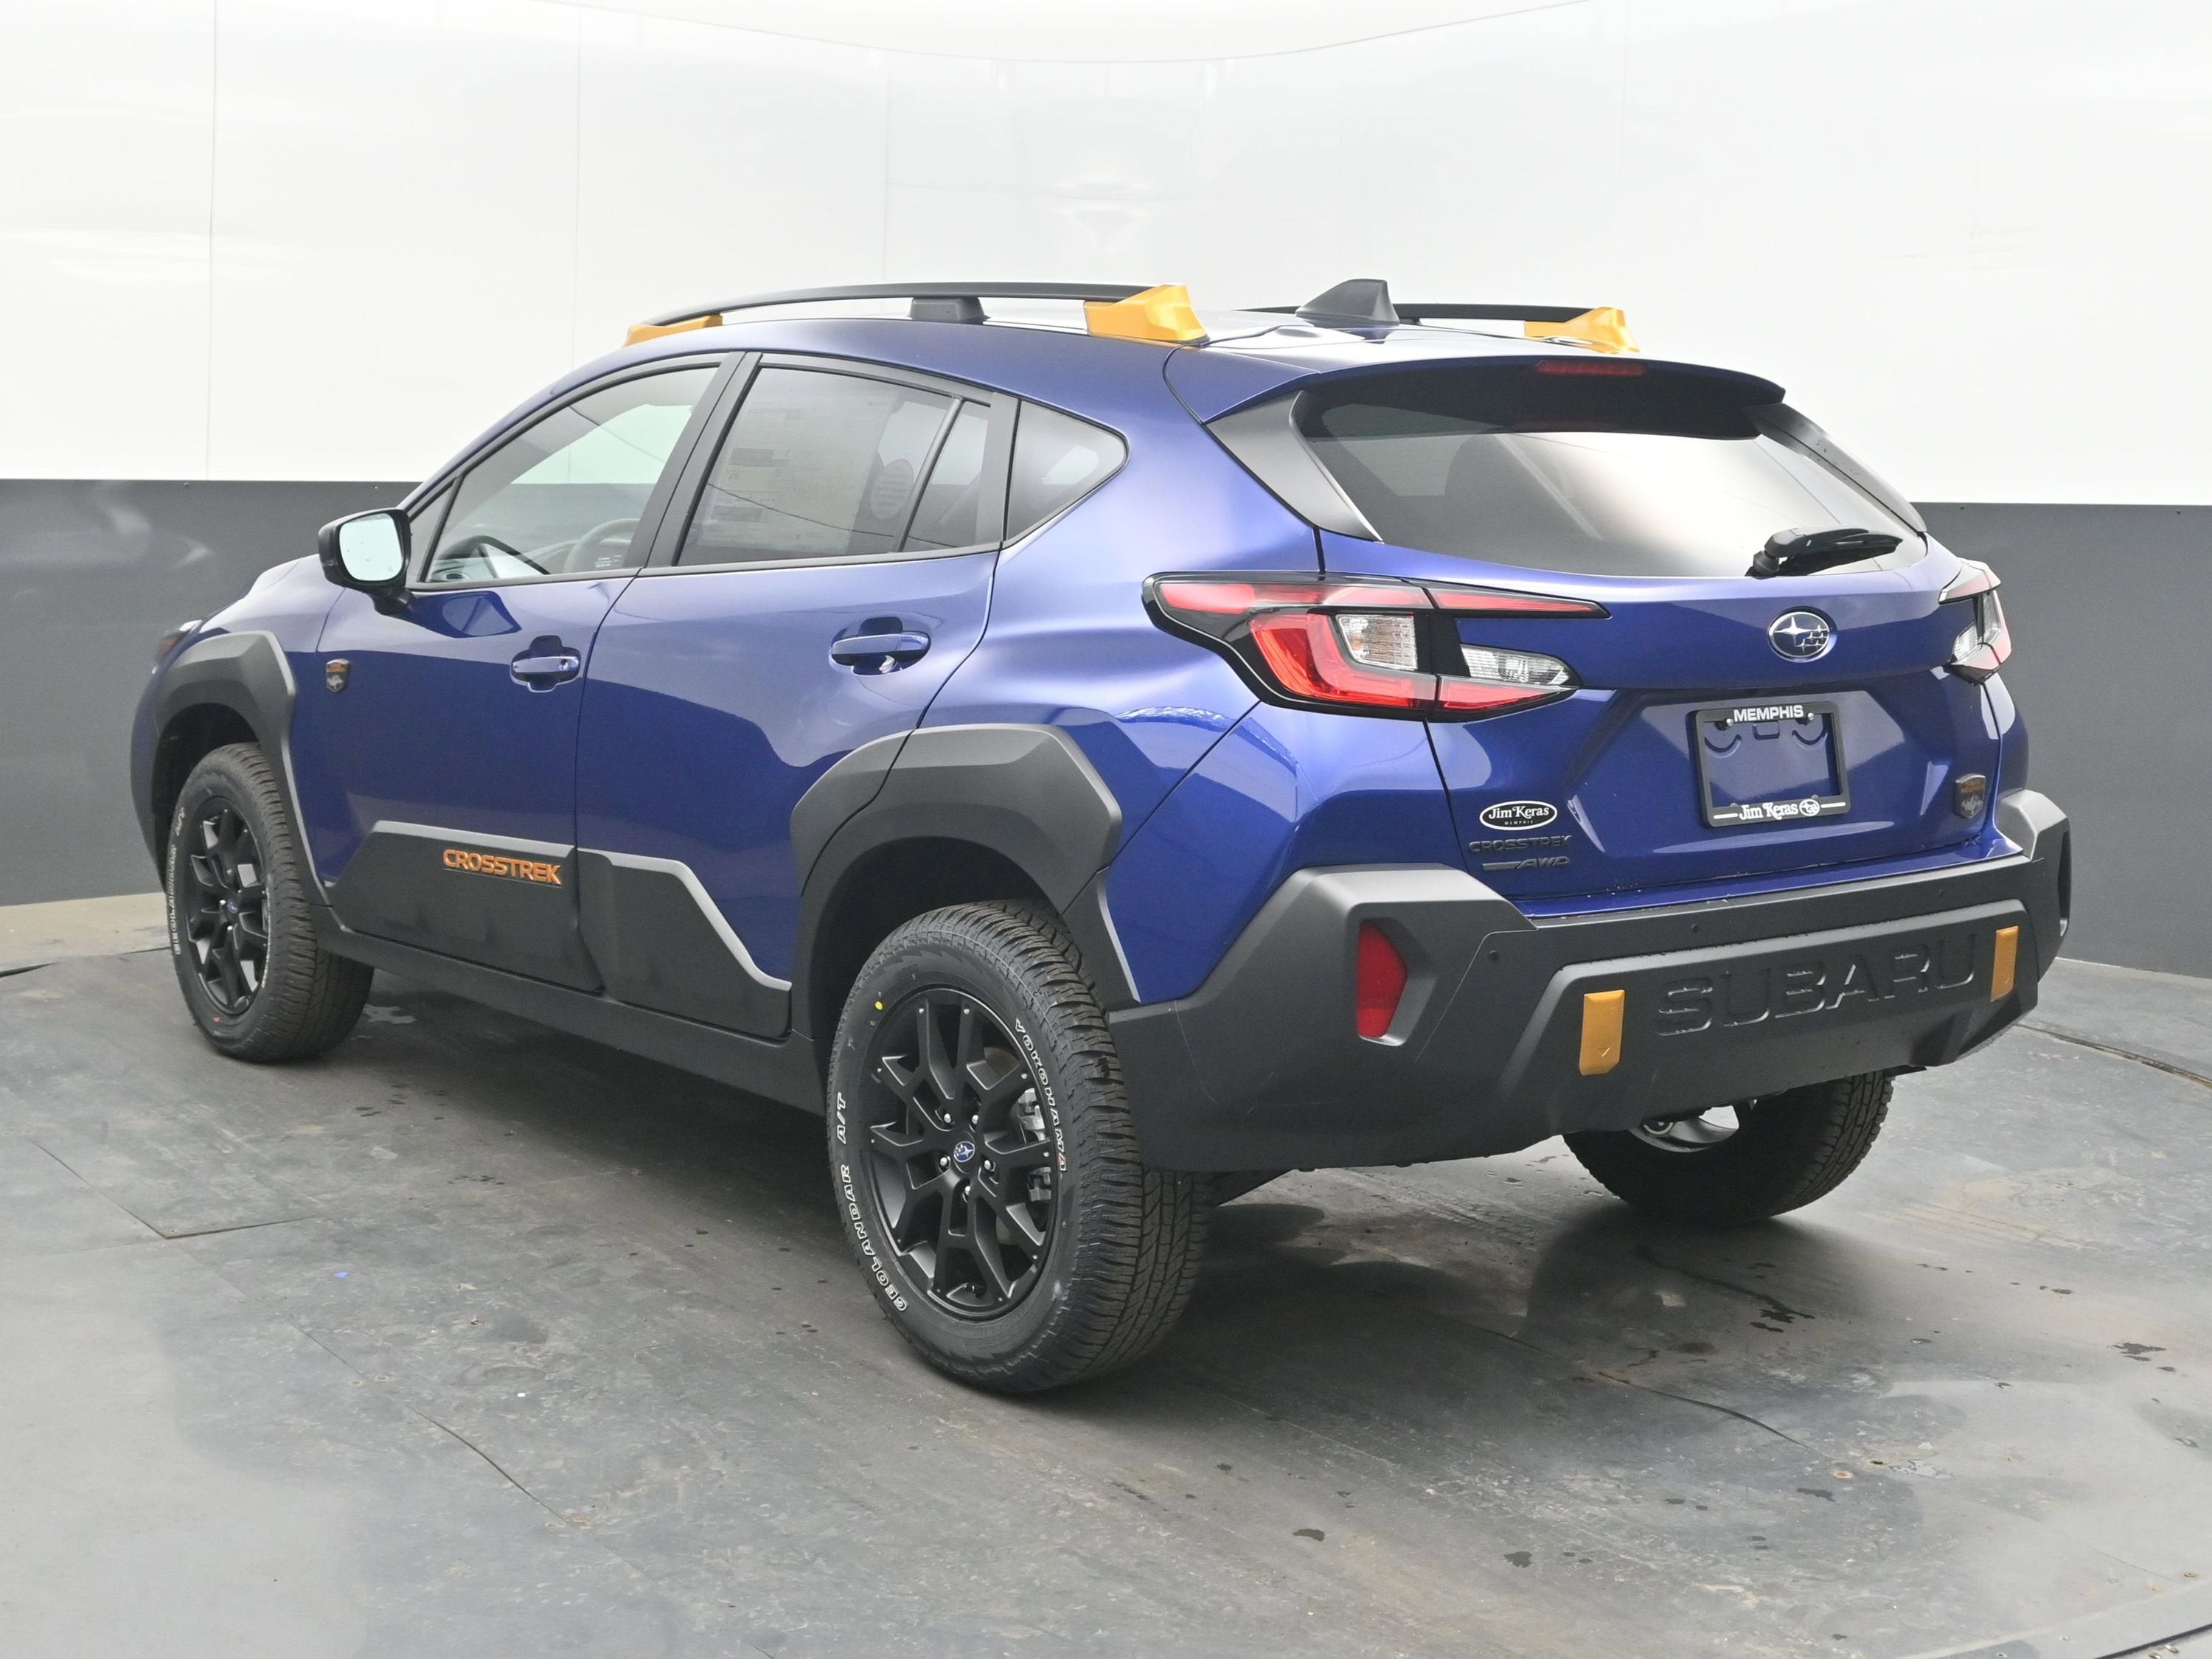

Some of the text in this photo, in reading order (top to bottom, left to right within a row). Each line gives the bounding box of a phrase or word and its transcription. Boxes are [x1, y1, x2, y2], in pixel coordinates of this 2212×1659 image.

[1733, 704, 1804, 722] MEMPHIS
[1488, 805, 1550, 819] Jim Keras
[1739, 801, 1799, 820] Jim Keras
[1469, 835, 1572, 852] CROSSTREK
[442, 849, 561, 885] CROSSTREK
[1516, 856, 1570, 869] AWD
[1657, 936, 1976, 1037] SUBARU
[1015, 1017, 1067, 1171] YOKOHAMA
[836, 1092, 907, 1312] GEOLANDAR A/T
